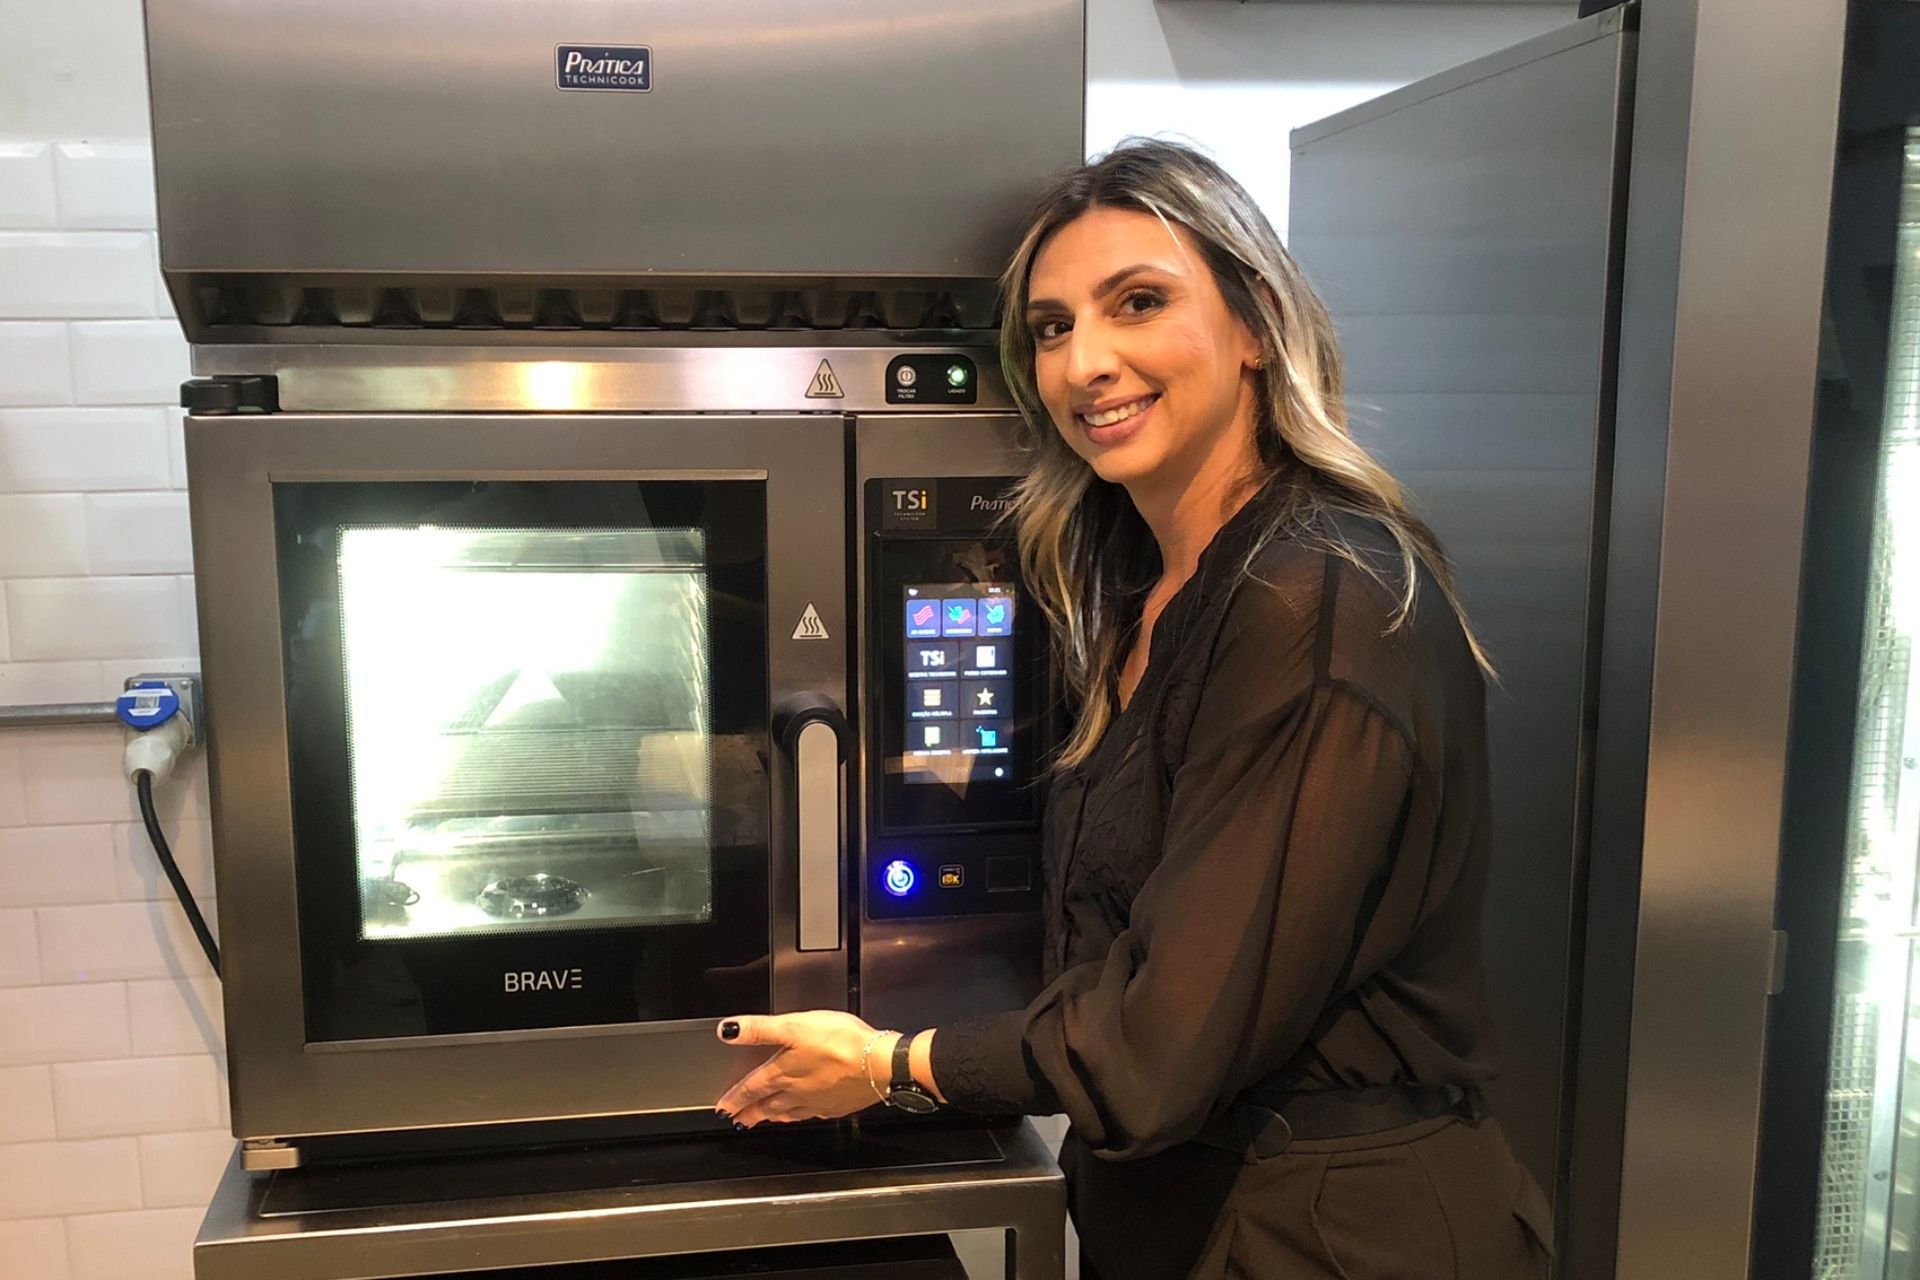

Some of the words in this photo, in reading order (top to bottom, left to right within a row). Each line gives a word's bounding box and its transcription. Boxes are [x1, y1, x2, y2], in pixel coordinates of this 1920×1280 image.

[565, 75, 644, 85] TECHNICOOK
[892, 490, 927, 510] TSi
[920, 650, 945, 667] TSi
[504, 968, 582, 992] BRAVE
